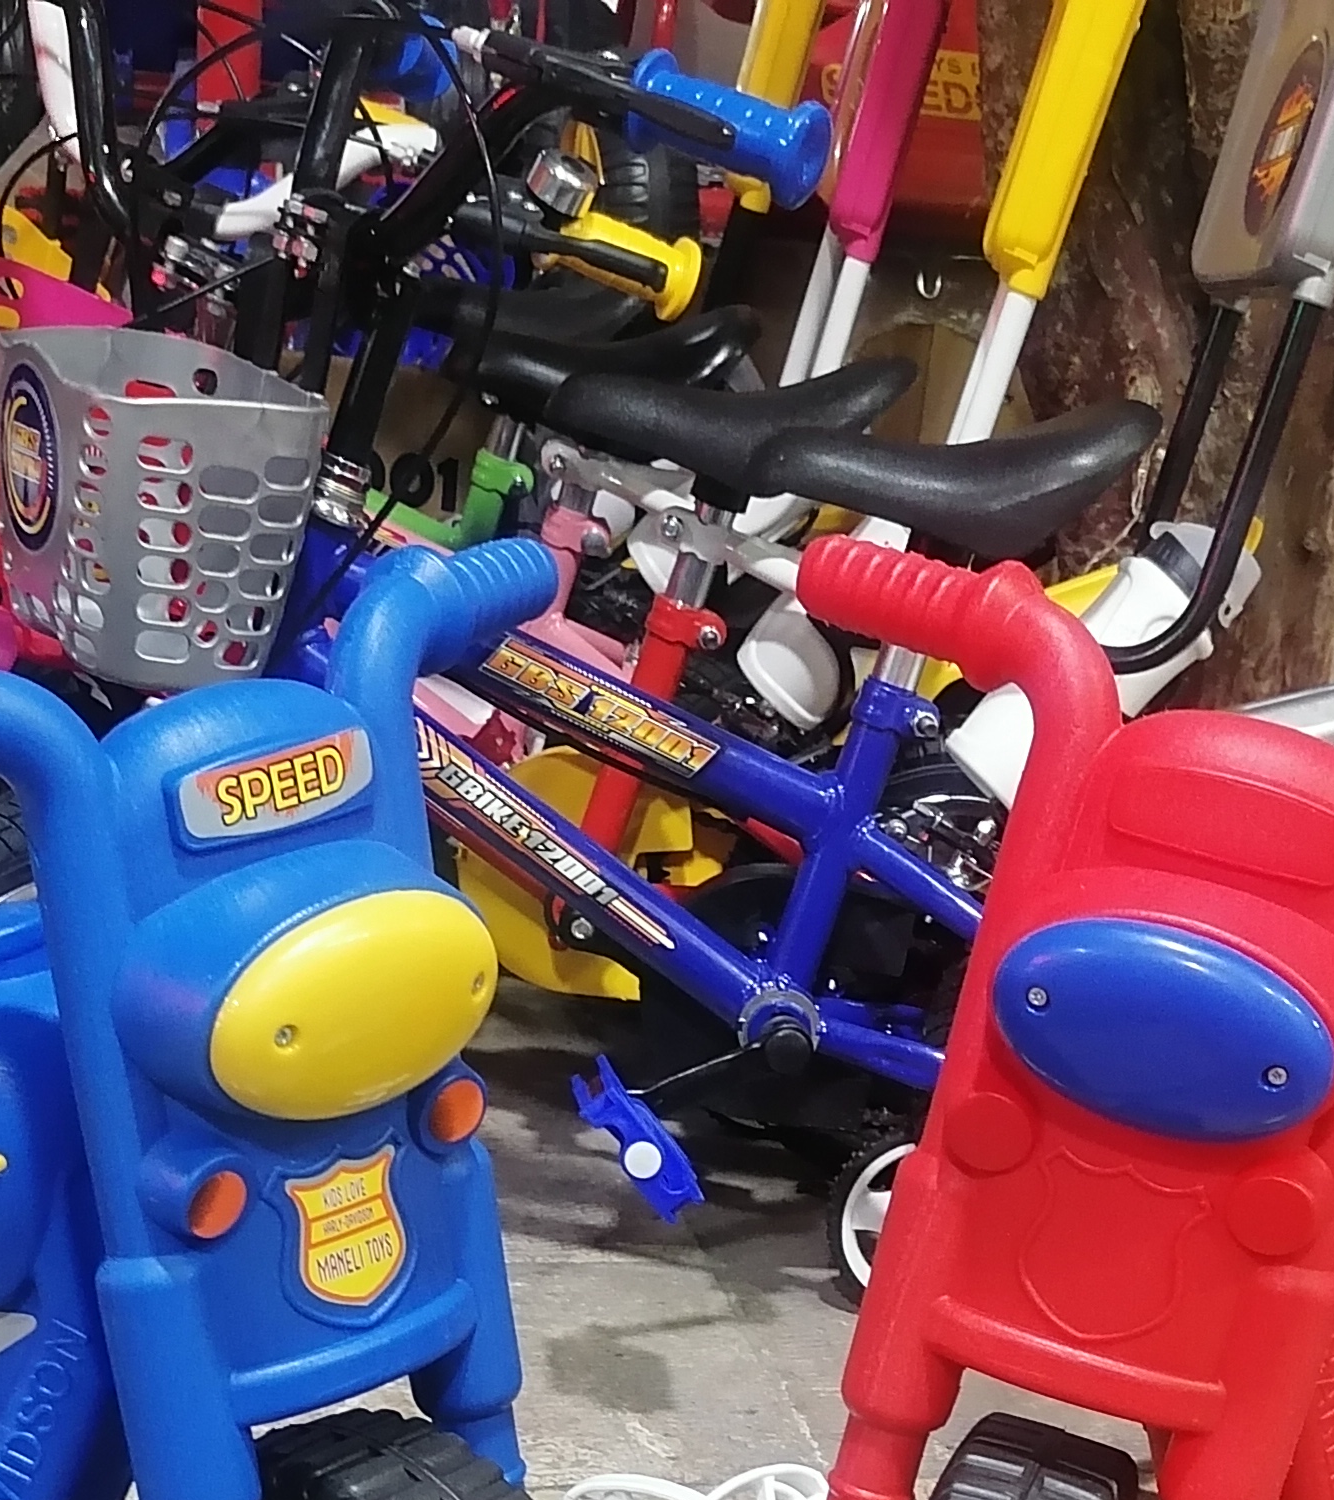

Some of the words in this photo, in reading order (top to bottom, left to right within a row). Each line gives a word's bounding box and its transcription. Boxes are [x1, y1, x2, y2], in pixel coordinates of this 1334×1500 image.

[585, 694, 718, 775] 12001
[216, 745, 345, 826] SPEED
[322, 1185, 344, 1210] KIDS
[344, 1176, 367, 1203] LOVE
[316, 1243, 365, 1284] MANELI
[365, 1232, 394, 1265] TOYS
